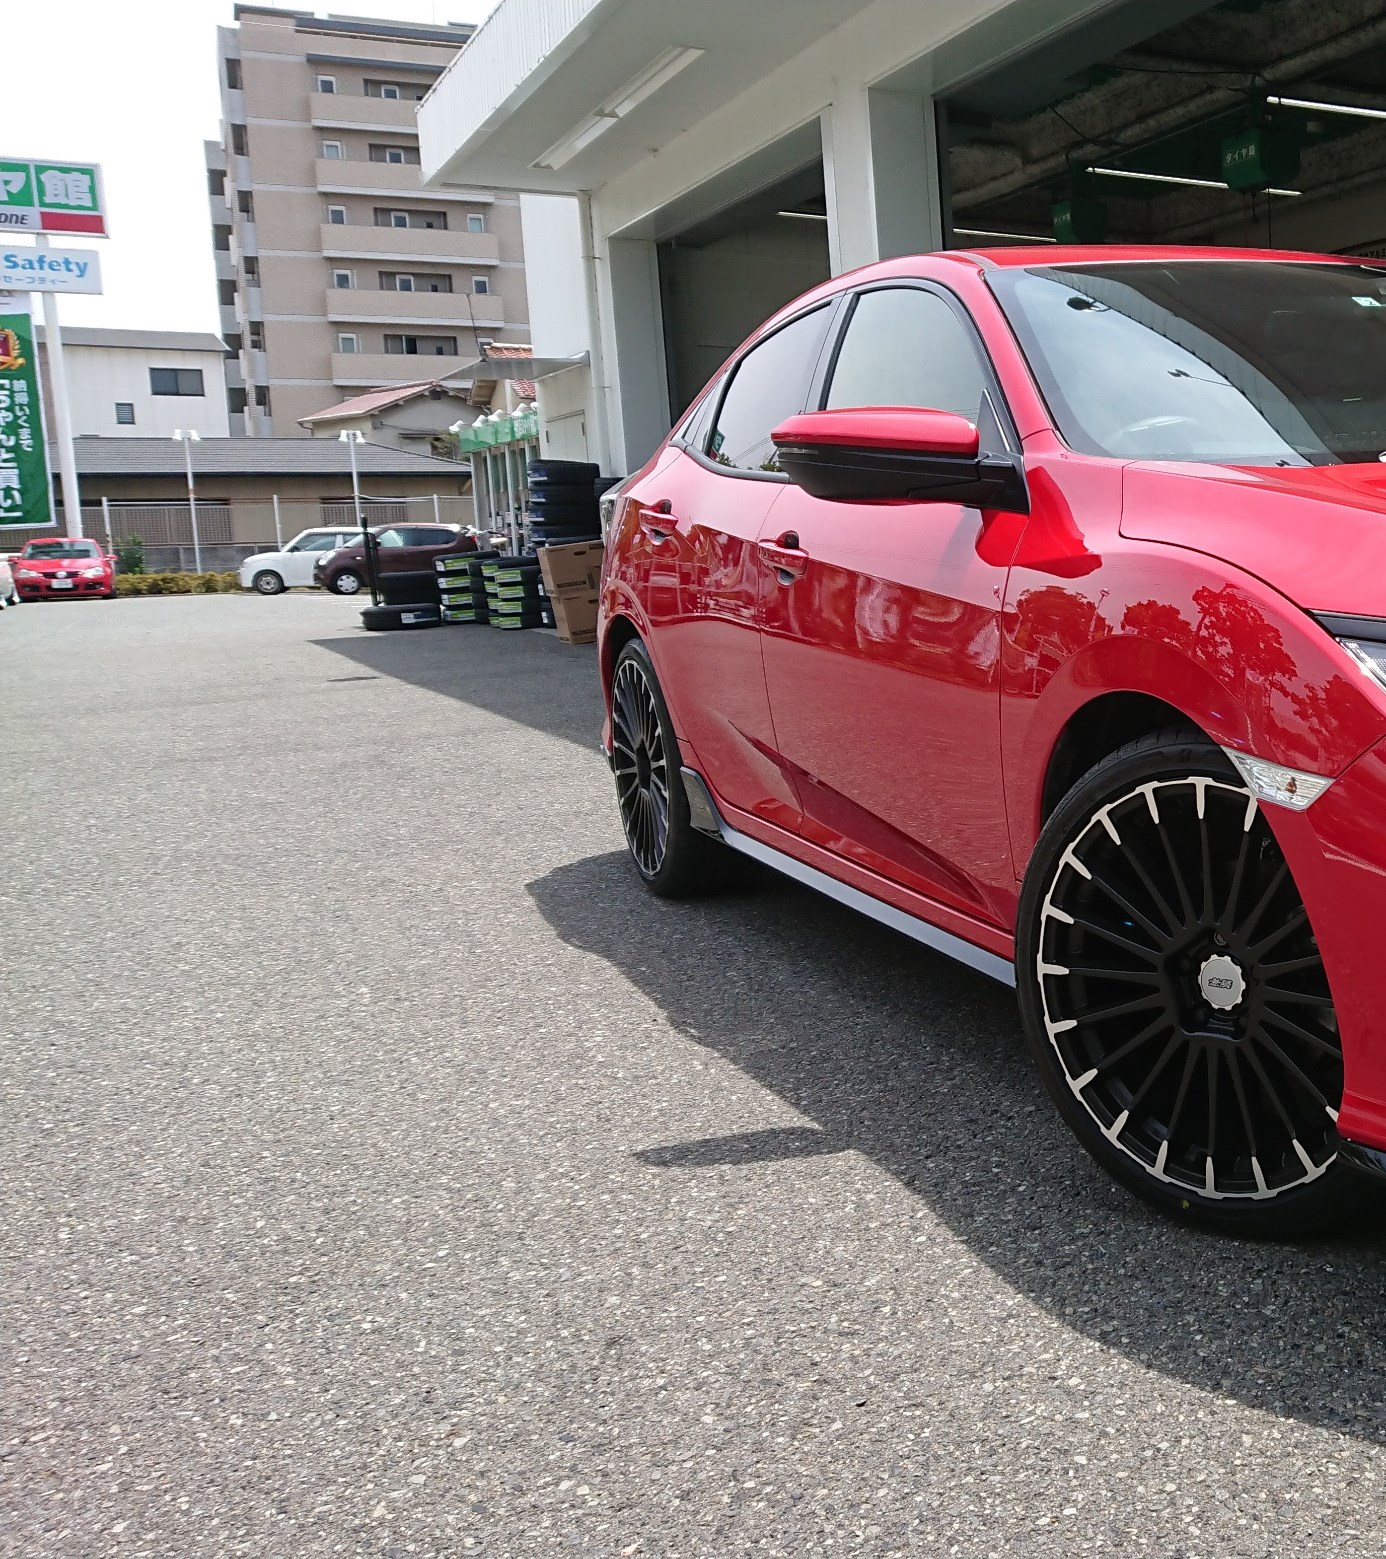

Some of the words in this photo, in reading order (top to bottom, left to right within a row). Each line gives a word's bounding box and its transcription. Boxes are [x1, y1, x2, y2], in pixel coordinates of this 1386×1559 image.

[4, 253, 89, 278] Safety
[3, 274, 69, 286] セーフティー
